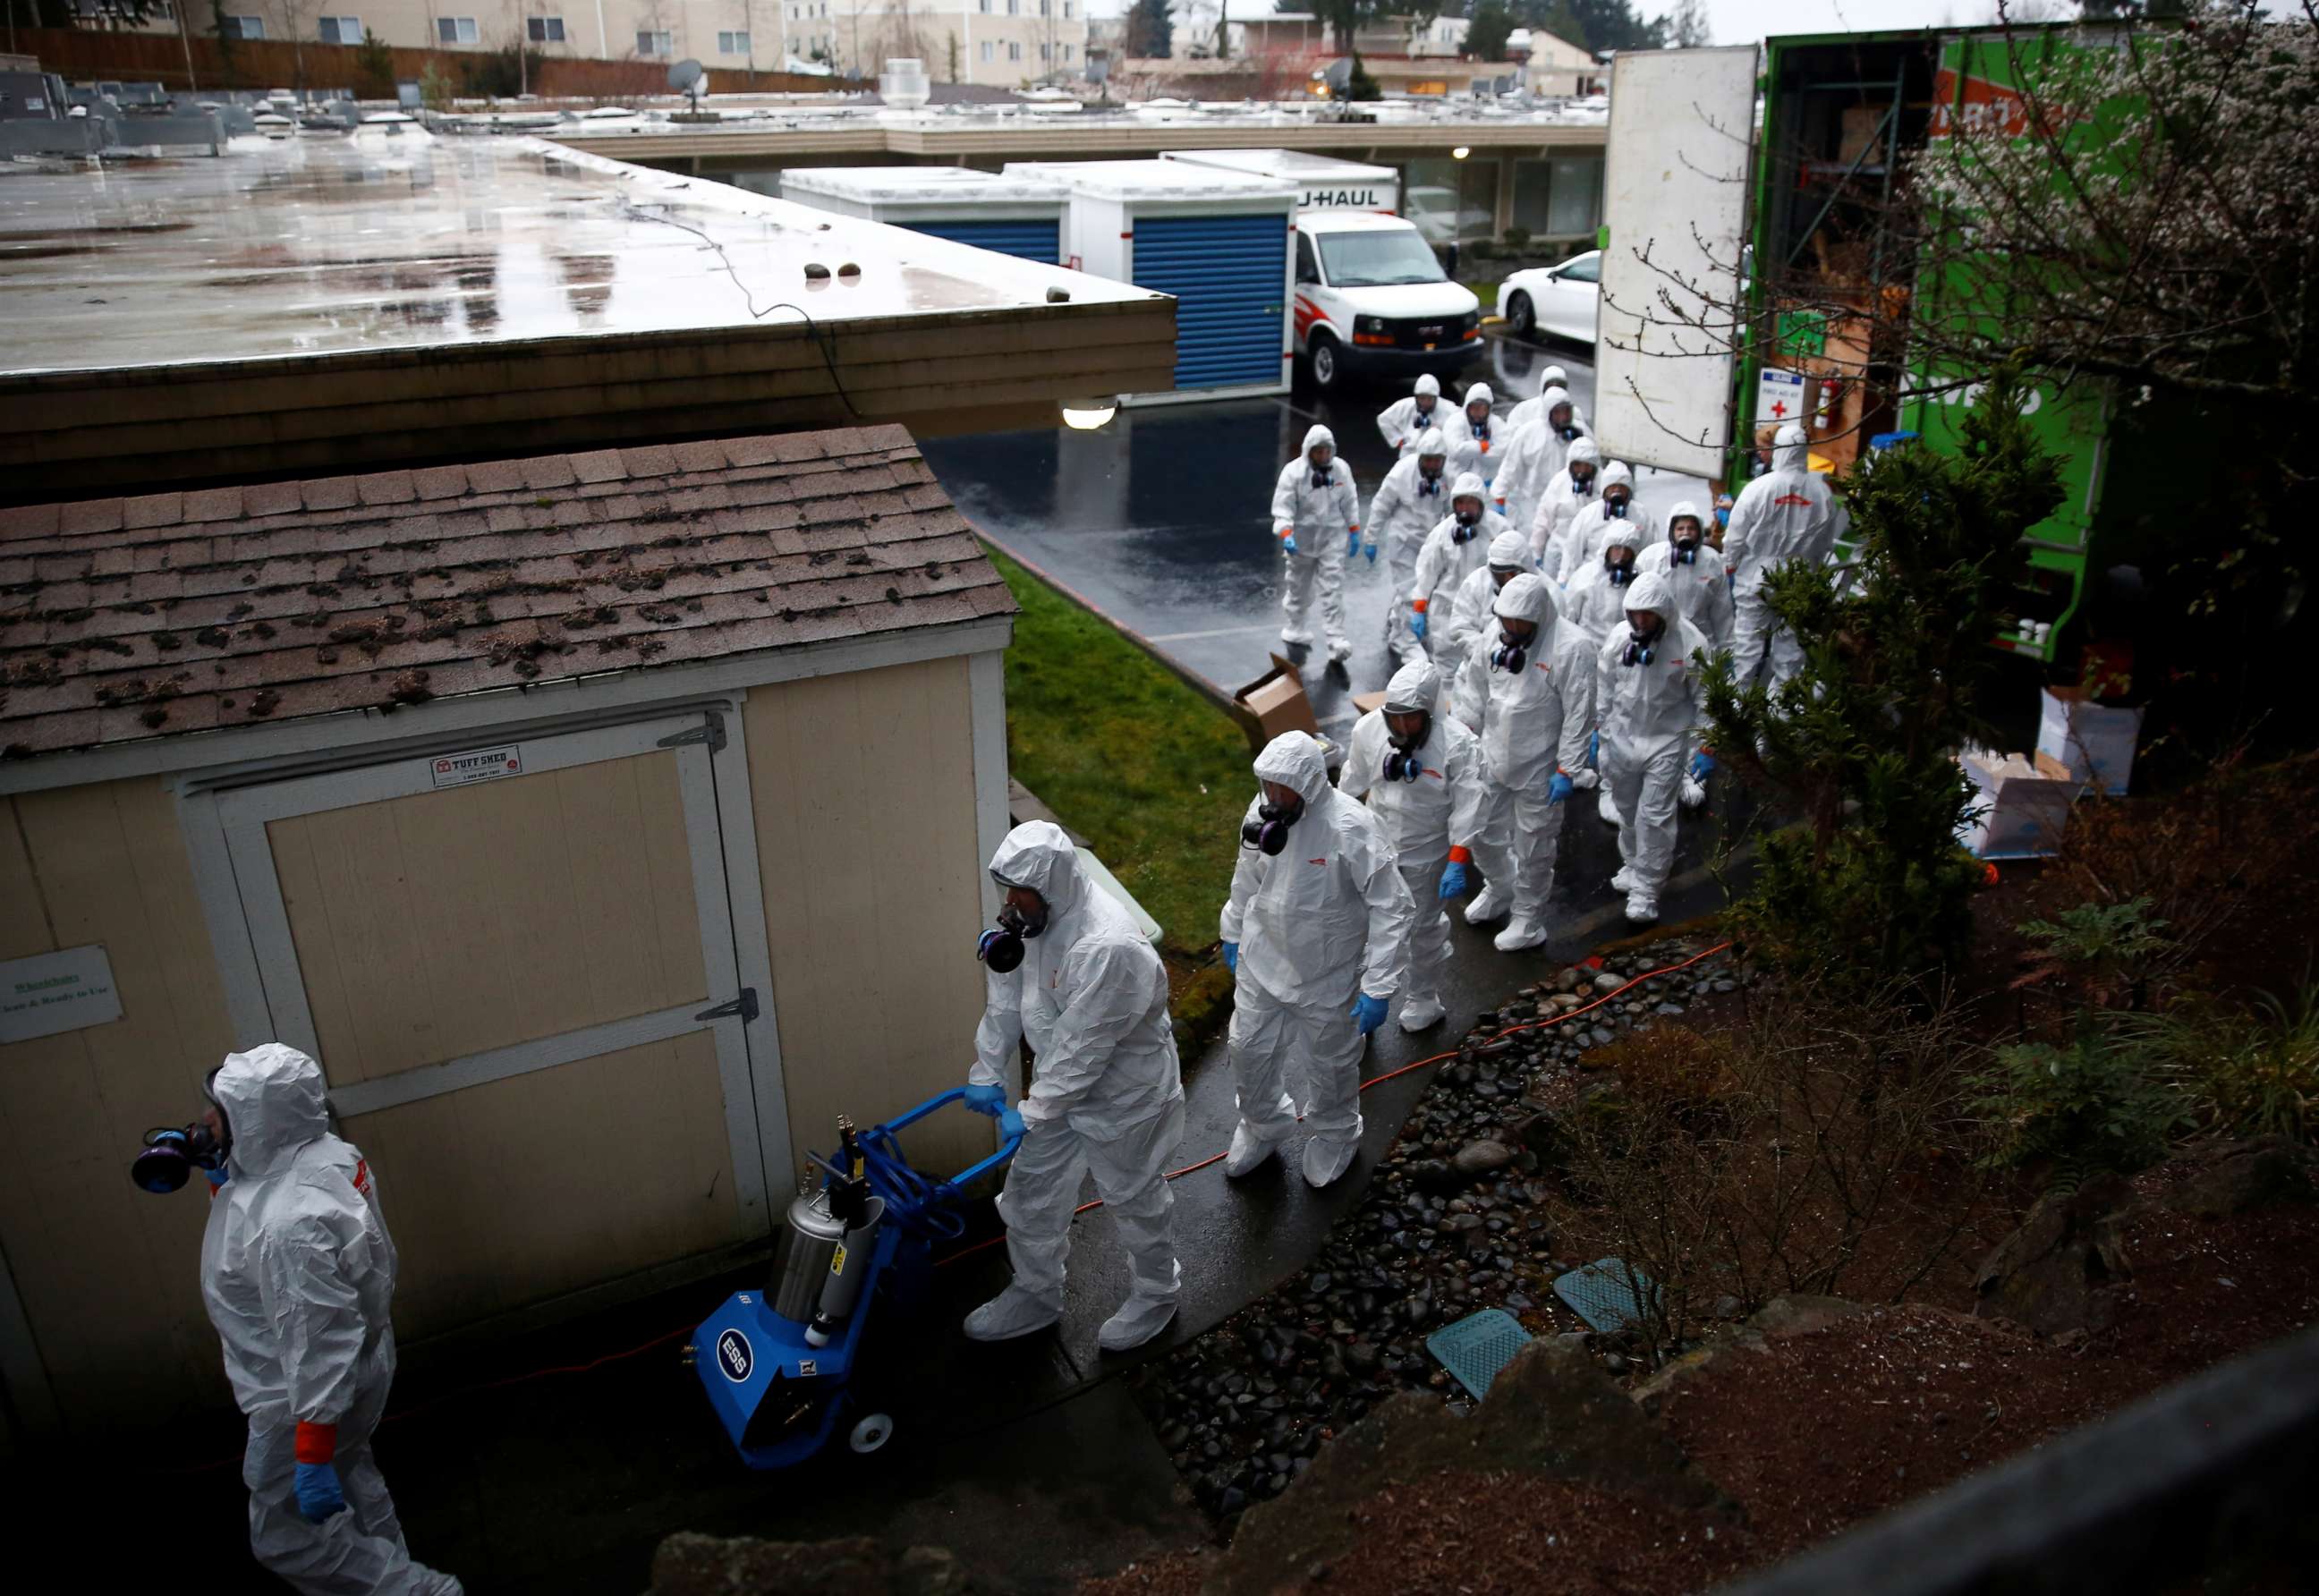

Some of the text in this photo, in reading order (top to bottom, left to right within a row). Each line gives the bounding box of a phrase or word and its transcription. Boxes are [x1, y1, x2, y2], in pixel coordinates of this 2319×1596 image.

[452, 757, 480, 770] TUFF
[480, 752, 507, 766] SHED
[722, 1337, 747, 1374] ESS
